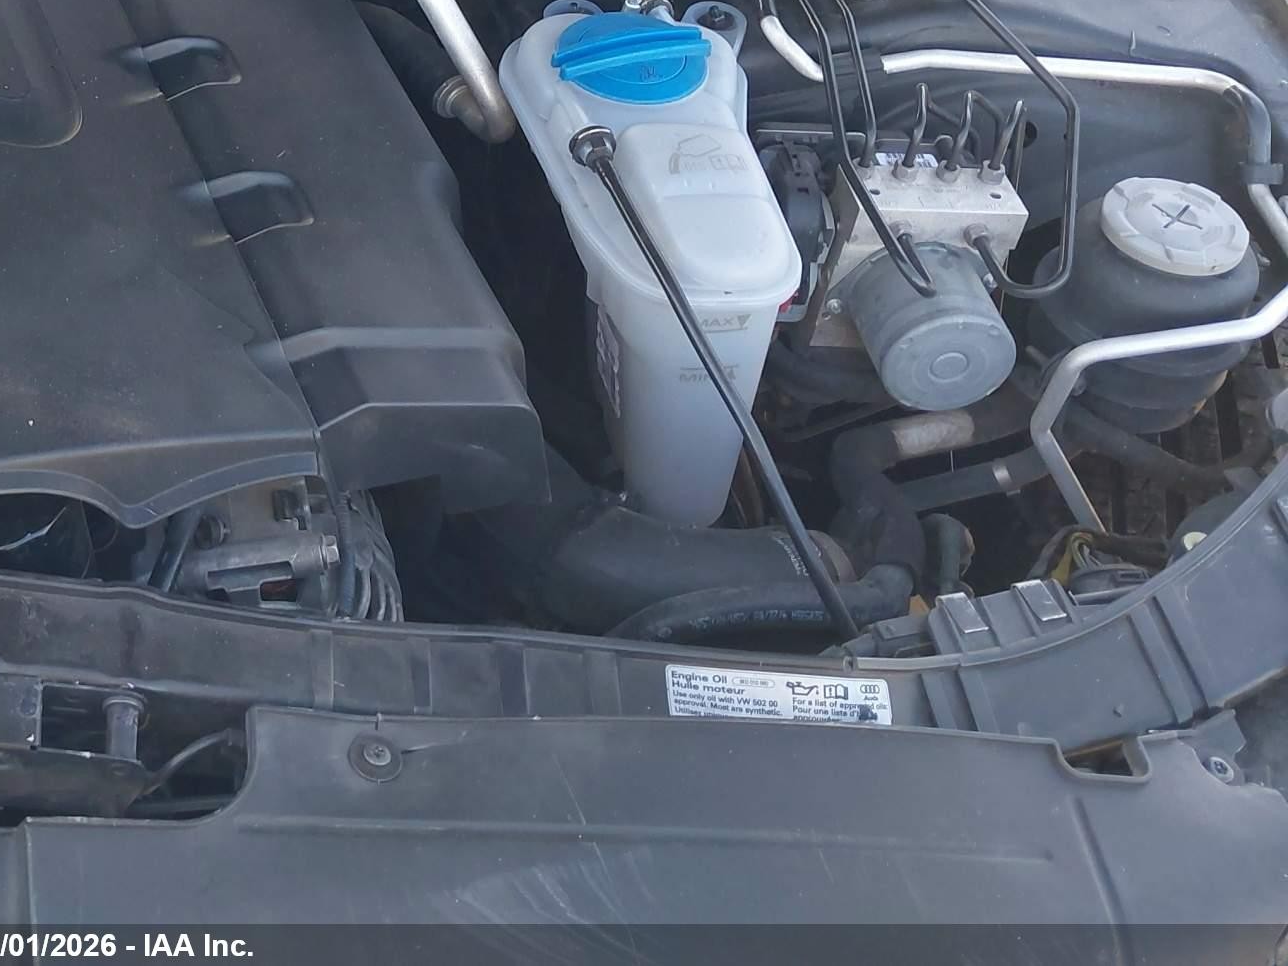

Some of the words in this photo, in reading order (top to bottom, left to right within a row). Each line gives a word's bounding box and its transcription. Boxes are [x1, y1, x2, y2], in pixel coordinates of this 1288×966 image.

[671, 670, 709, 684] Engine
[712, 674, 728, 684] Oil
[672, 679, 700, 691] Huile
[702, 685, 746, 695] moteur
[673, 690, 687, 698] Use
[689, 692, 705, 702] only
[707, 694, 717, 702] oil
[718, 695, 735, 704] with
[736, 697, 750, 706] VW
[752, 698, 767, 707] 502
[792, 696, 806, 705] For
[814, 699, 827, 707] list
[829, 700, 838, 708] of
[710, 702, 730, 711] Most
[730, 705, 744, 713] are
[745, 707, 784, 717] synthetic.
[792, 705, 812, 714] Pour
[831, 708, 848, 717] liste
